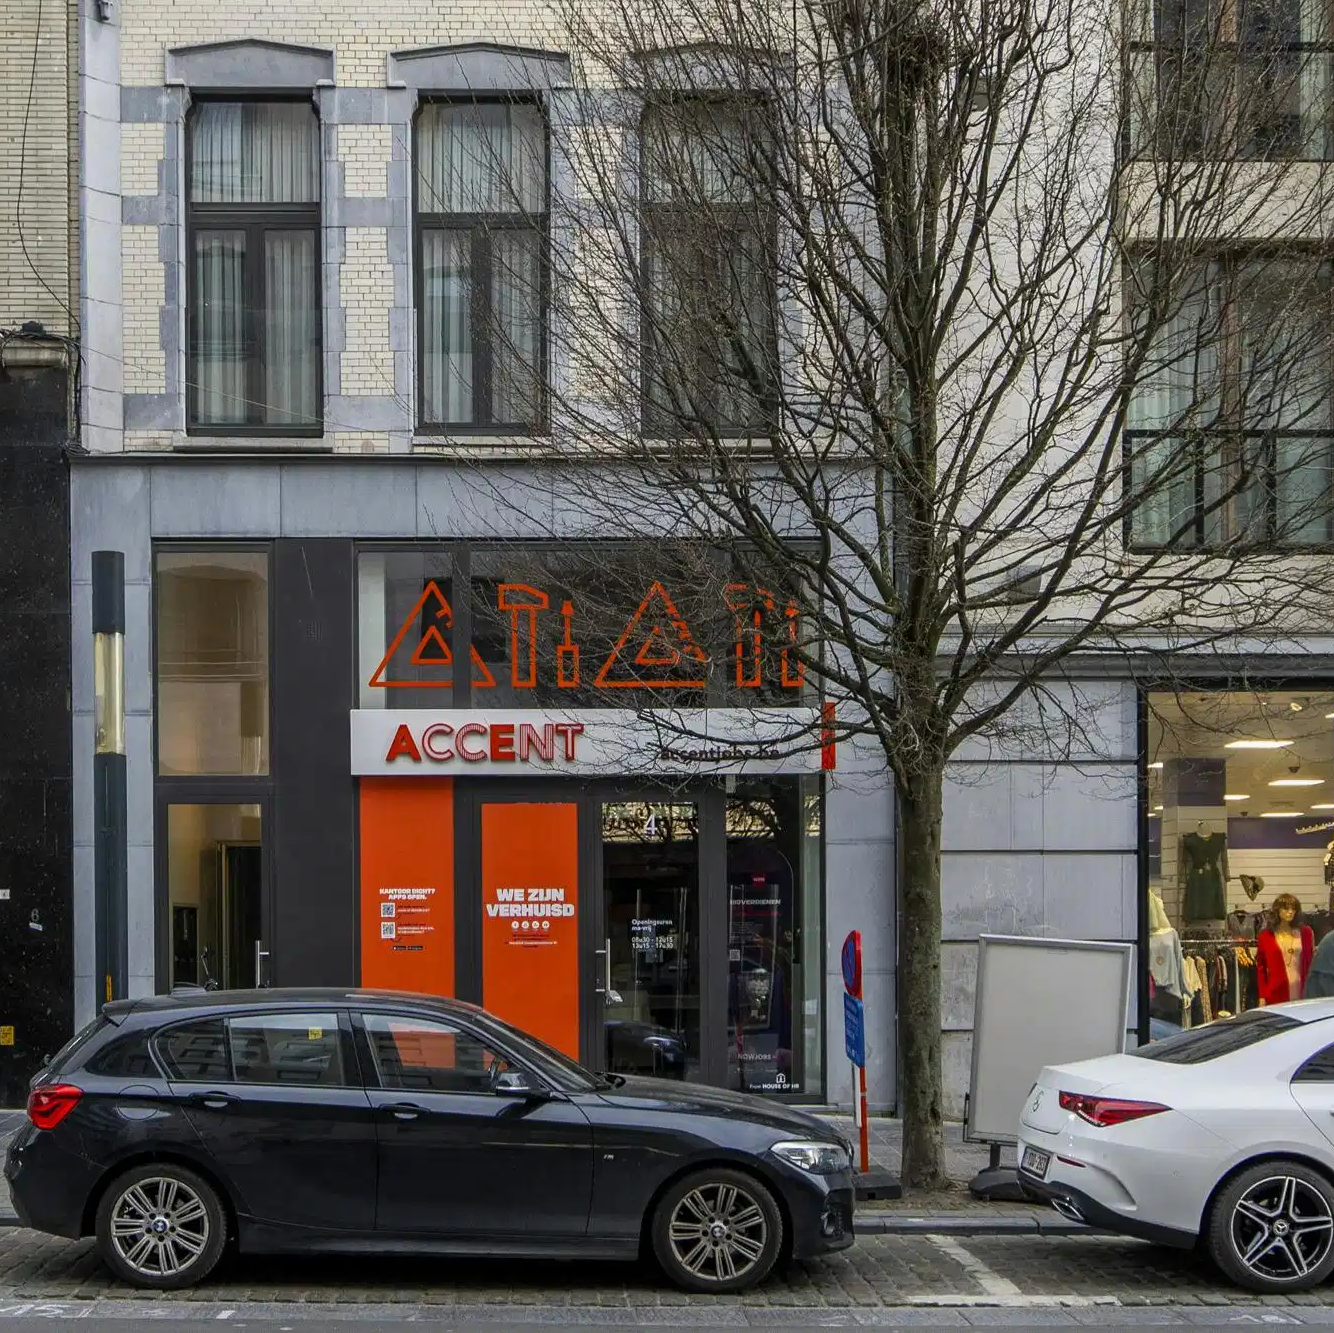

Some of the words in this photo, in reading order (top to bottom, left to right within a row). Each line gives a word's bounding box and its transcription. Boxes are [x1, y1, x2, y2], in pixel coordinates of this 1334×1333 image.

[386, 723, 585, 763] ACCENT
[644, 815, 658, 835] 4
[496, 888, 526, 902] WE
[528, 888, 564, 902] ZIJN
[30, 908, 40, 921] 6
[486, 903, 575, 917] VERHUISD
